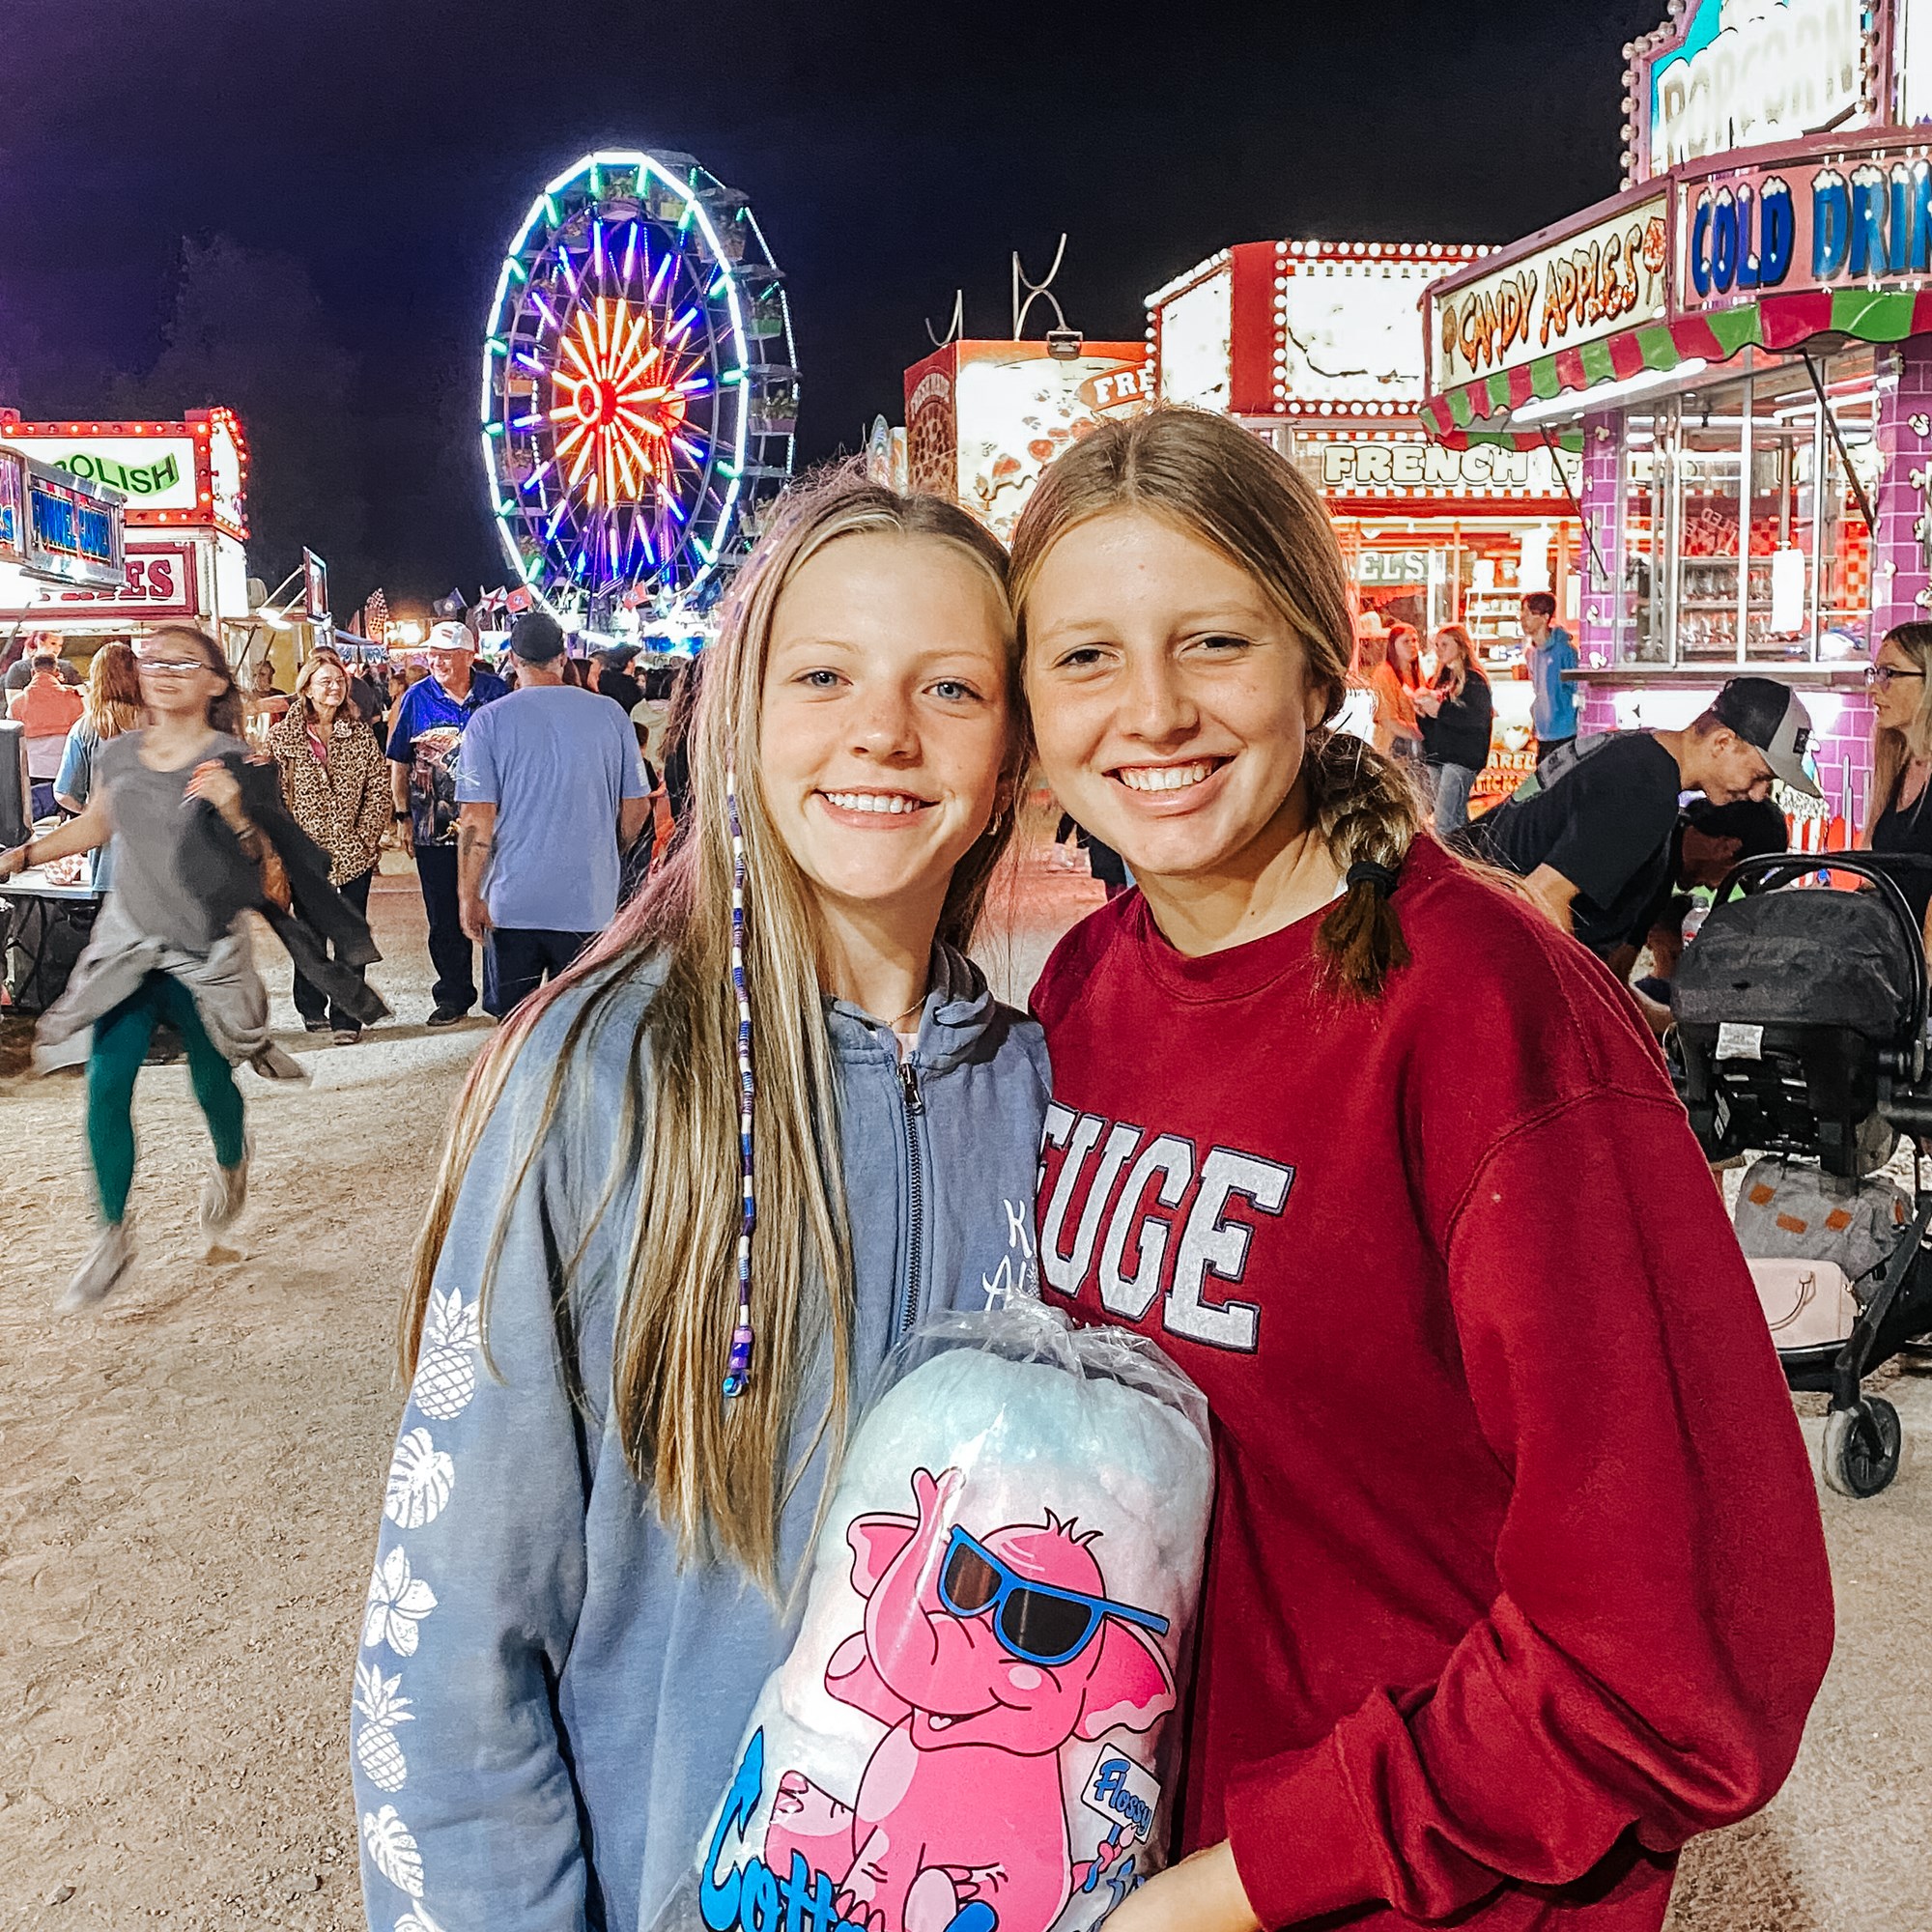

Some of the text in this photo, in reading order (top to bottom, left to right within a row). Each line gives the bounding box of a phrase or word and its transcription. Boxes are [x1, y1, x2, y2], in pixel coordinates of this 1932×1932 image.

[1459, 223, 1643, 373] CANDY APPLES
[1691, 175, 1794, 298] COLD
[1323, 443, 1528, 485] FRENCH
[698, 1725, 867, 1932] Cott
[1093, 1758, 1152, 1835] Flossy
